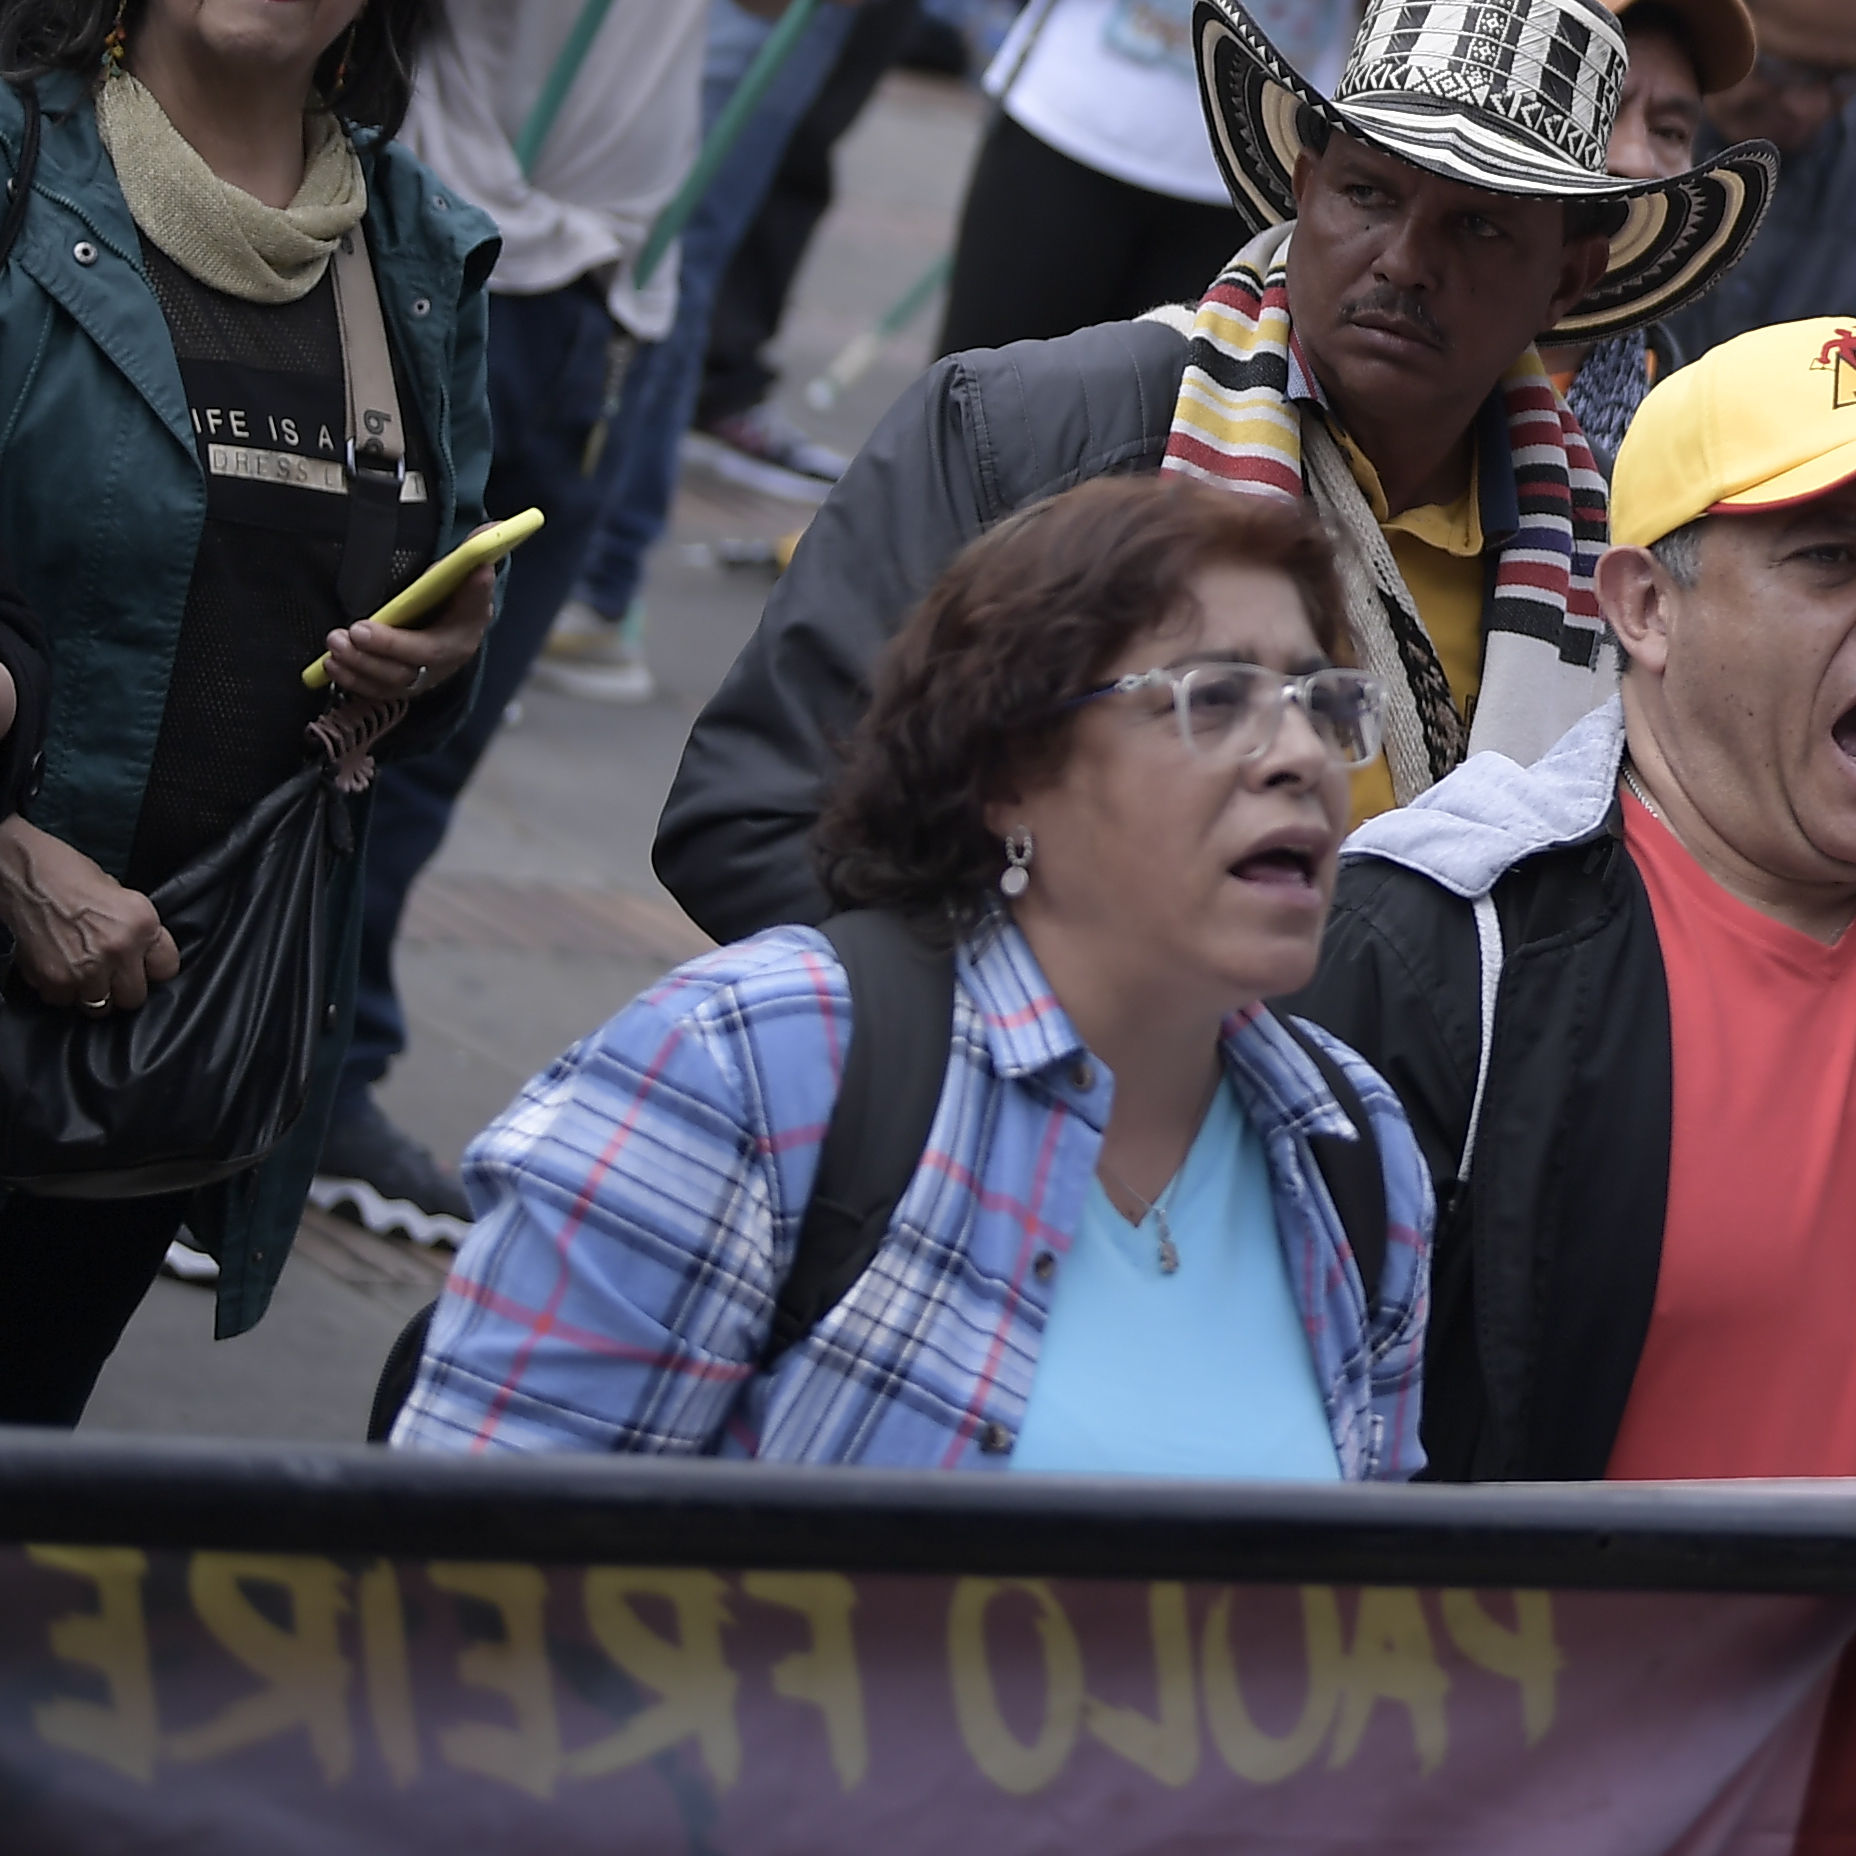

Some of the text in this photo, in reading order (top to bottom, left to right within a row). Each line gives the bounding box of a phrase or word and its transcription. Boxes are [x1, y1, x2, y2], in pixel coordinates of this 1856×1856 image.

[191, 408, 334, 451] IFE IS A
[212, 448, 309, 484] DRESS
